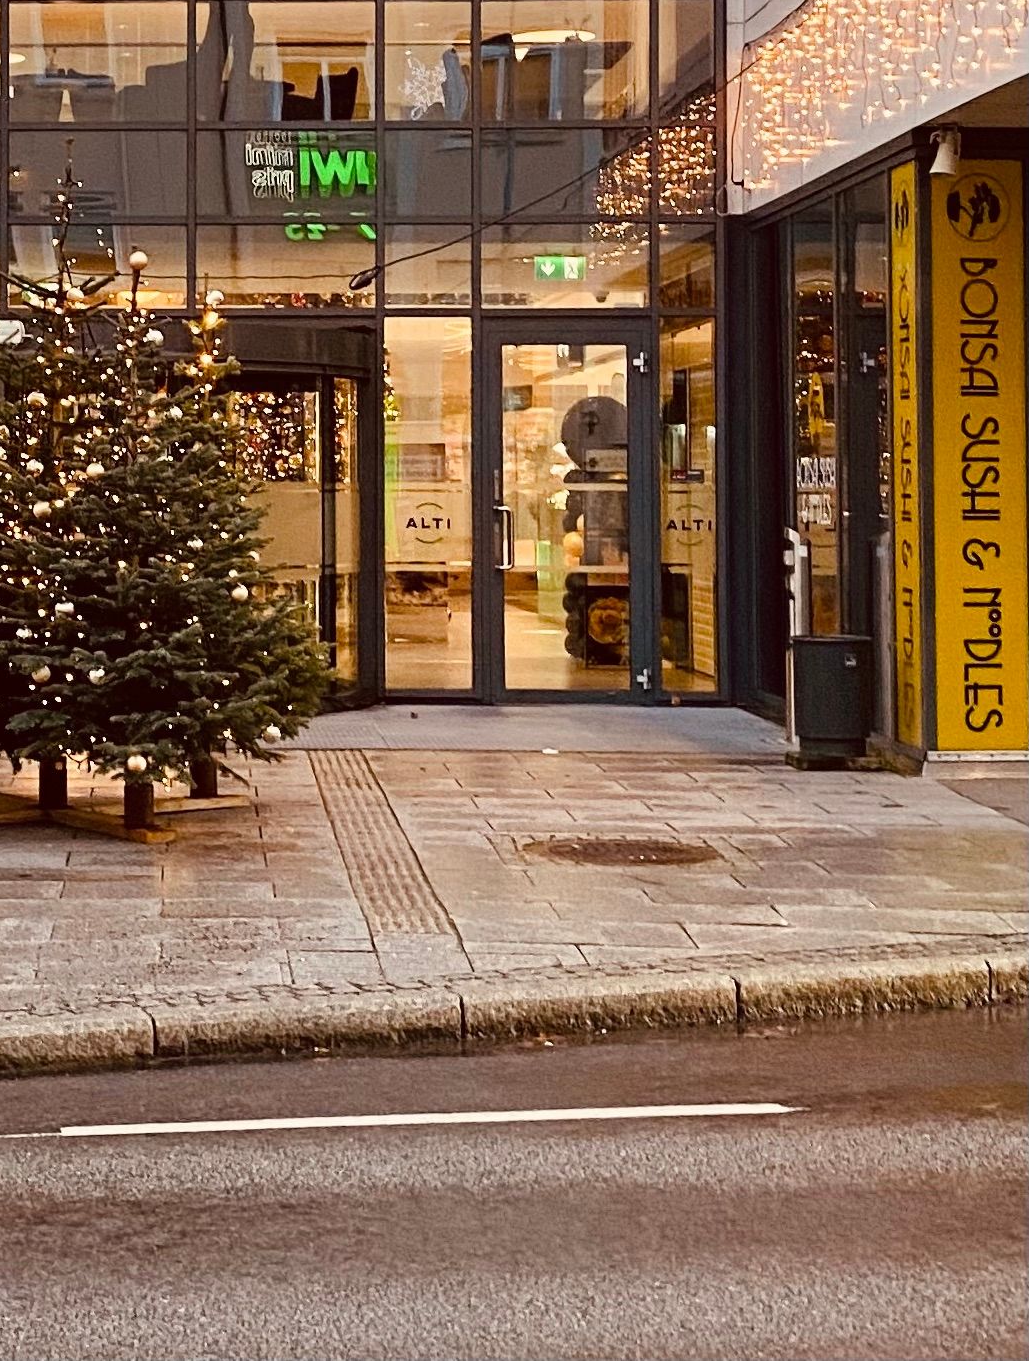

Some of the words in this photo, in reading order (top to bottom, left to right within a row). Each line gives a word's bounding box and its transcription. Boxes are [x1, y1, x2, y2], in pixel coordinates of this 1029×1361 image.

[960, 257, 999, 397] BONSAI
[900, 418, 912, 522] SUSHI
[961, 413, 1000, 521] SUSHI
[406, 517, 451, 530] ALTI
[666, 519, 713, 532] ALTI
[962, 539, 1000, 571] &
[962, 587, 1003, 733] NOODLES
